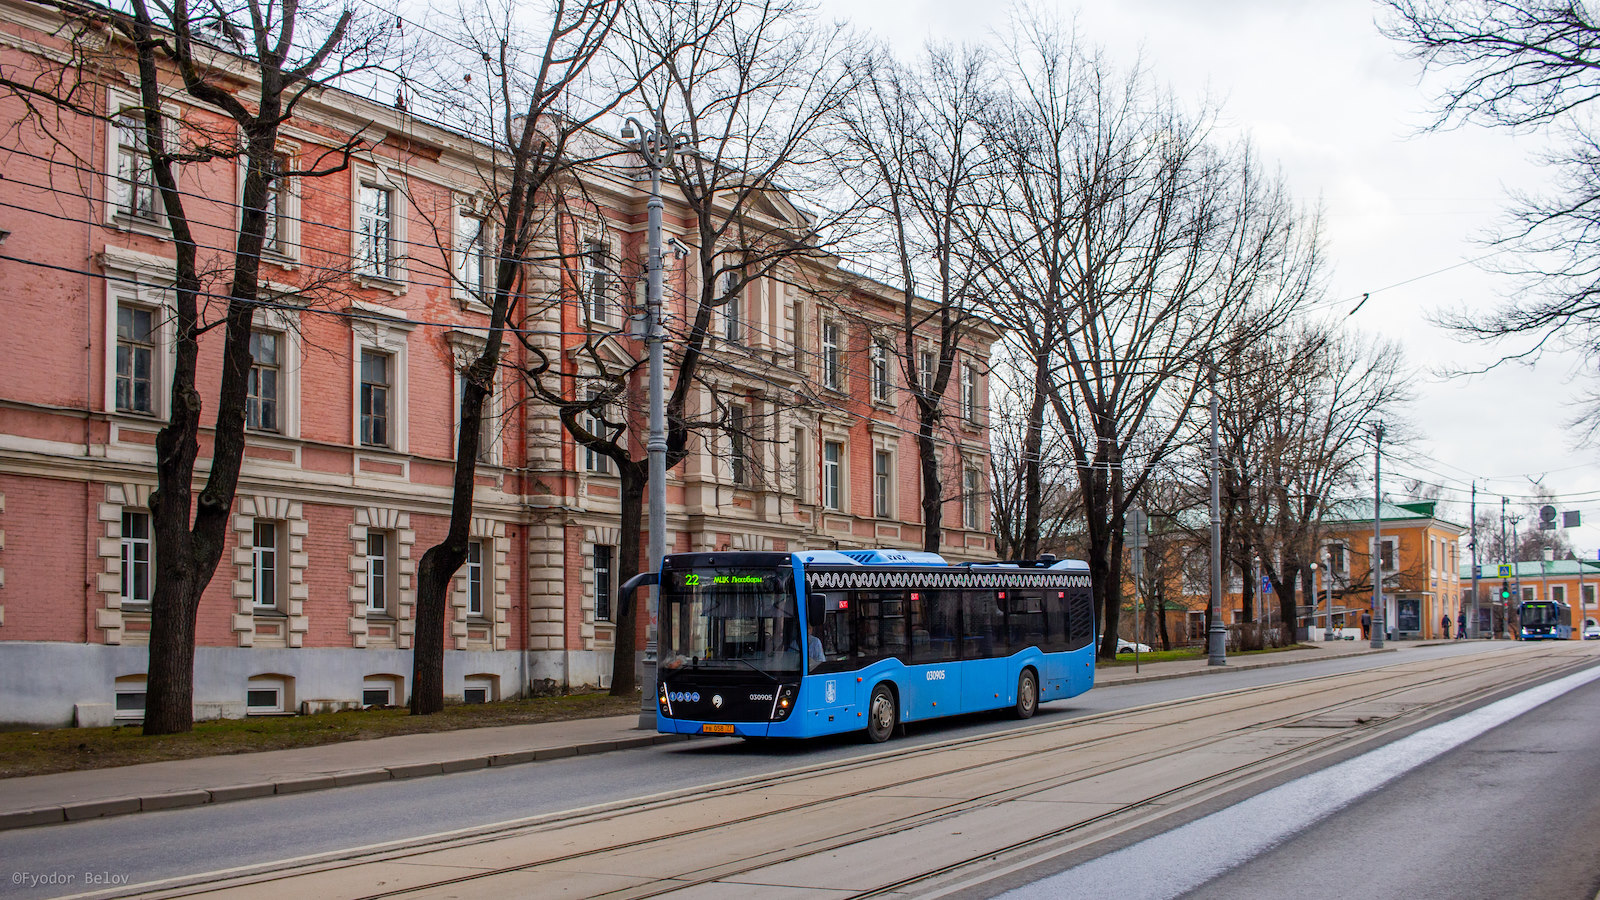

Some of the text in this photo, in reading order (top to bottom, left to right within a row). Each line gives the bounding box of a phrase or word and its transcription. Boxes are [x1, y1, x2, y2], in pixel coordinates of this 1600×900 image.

[685, 574, 699, 585] 22
[713, 576, 729, 584] МЦК
[926, 670, 945, 681] 030905
